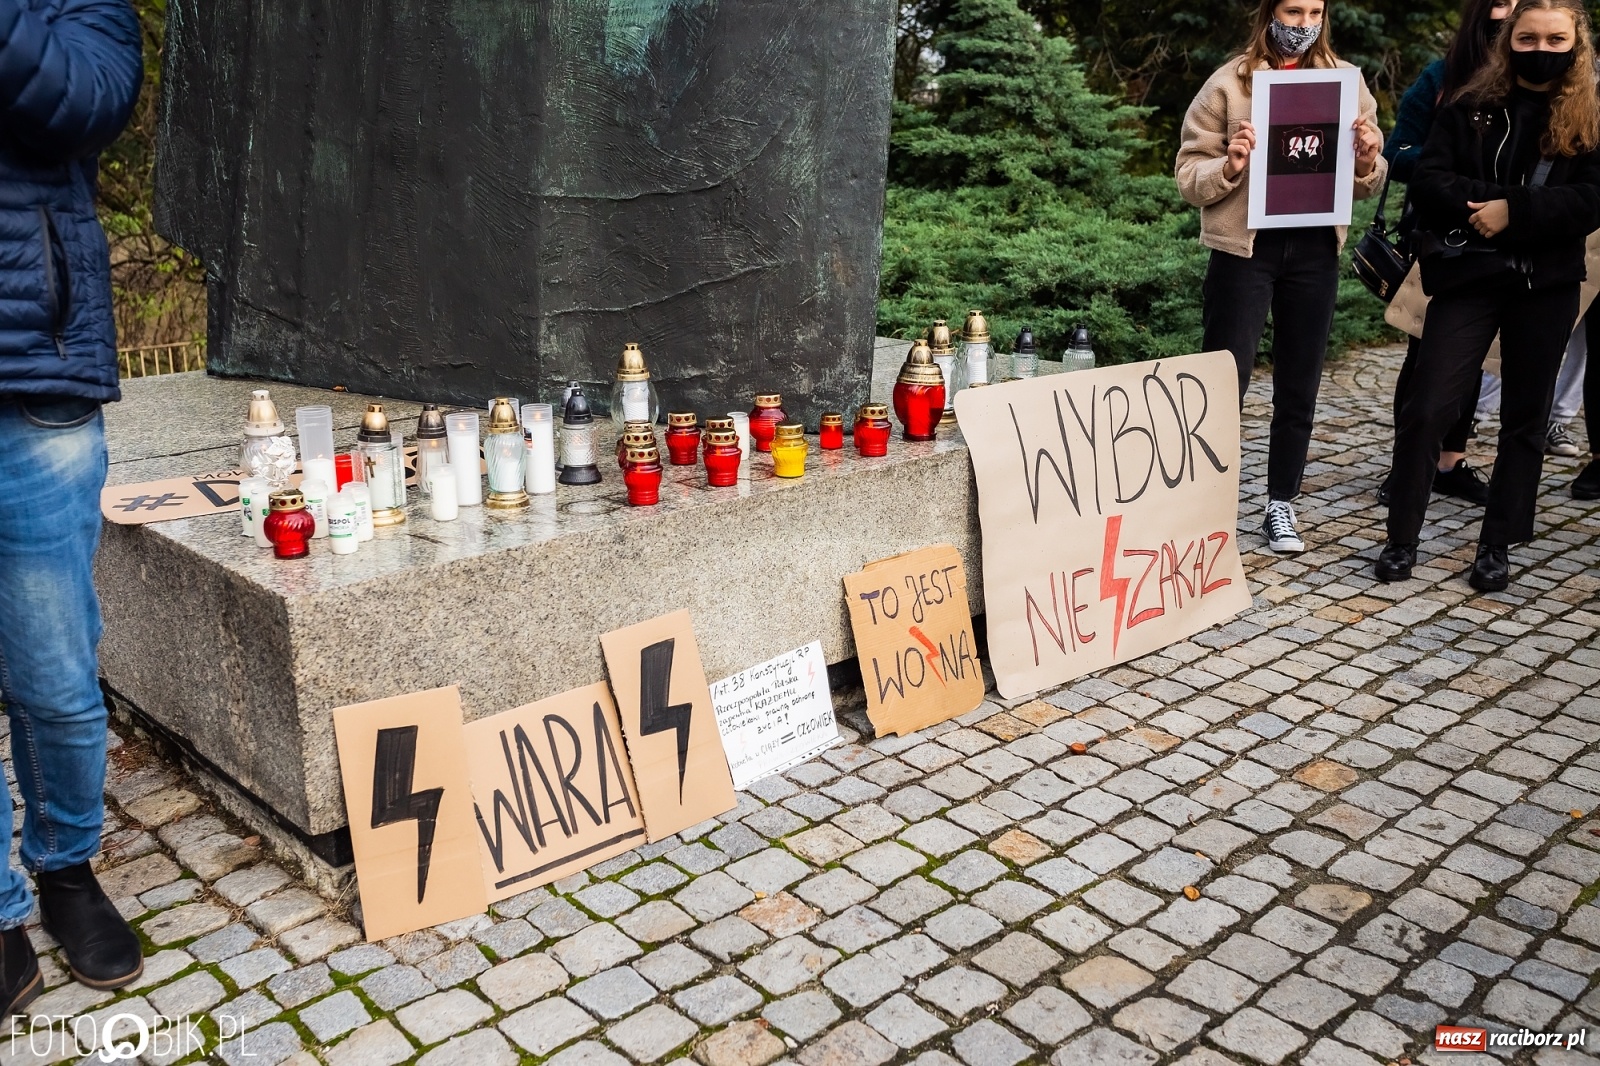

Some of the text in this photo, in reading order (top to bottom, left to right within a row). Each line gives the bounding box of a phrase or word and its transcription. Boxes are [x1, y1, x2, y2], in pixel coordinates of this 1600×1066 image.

[1008, 362, 1229, 524] WYBÓR
[860, 565, 958, 625] TO JEST
[1024, 531, 1232, 666] NIE ZAKAZ
[732, 673, 745, 692] 38
[771, 676, 799, 689] Polska
[797, 710, 834, 738] CZŁOWIEK
[473, 701, 637, 873] WARA
